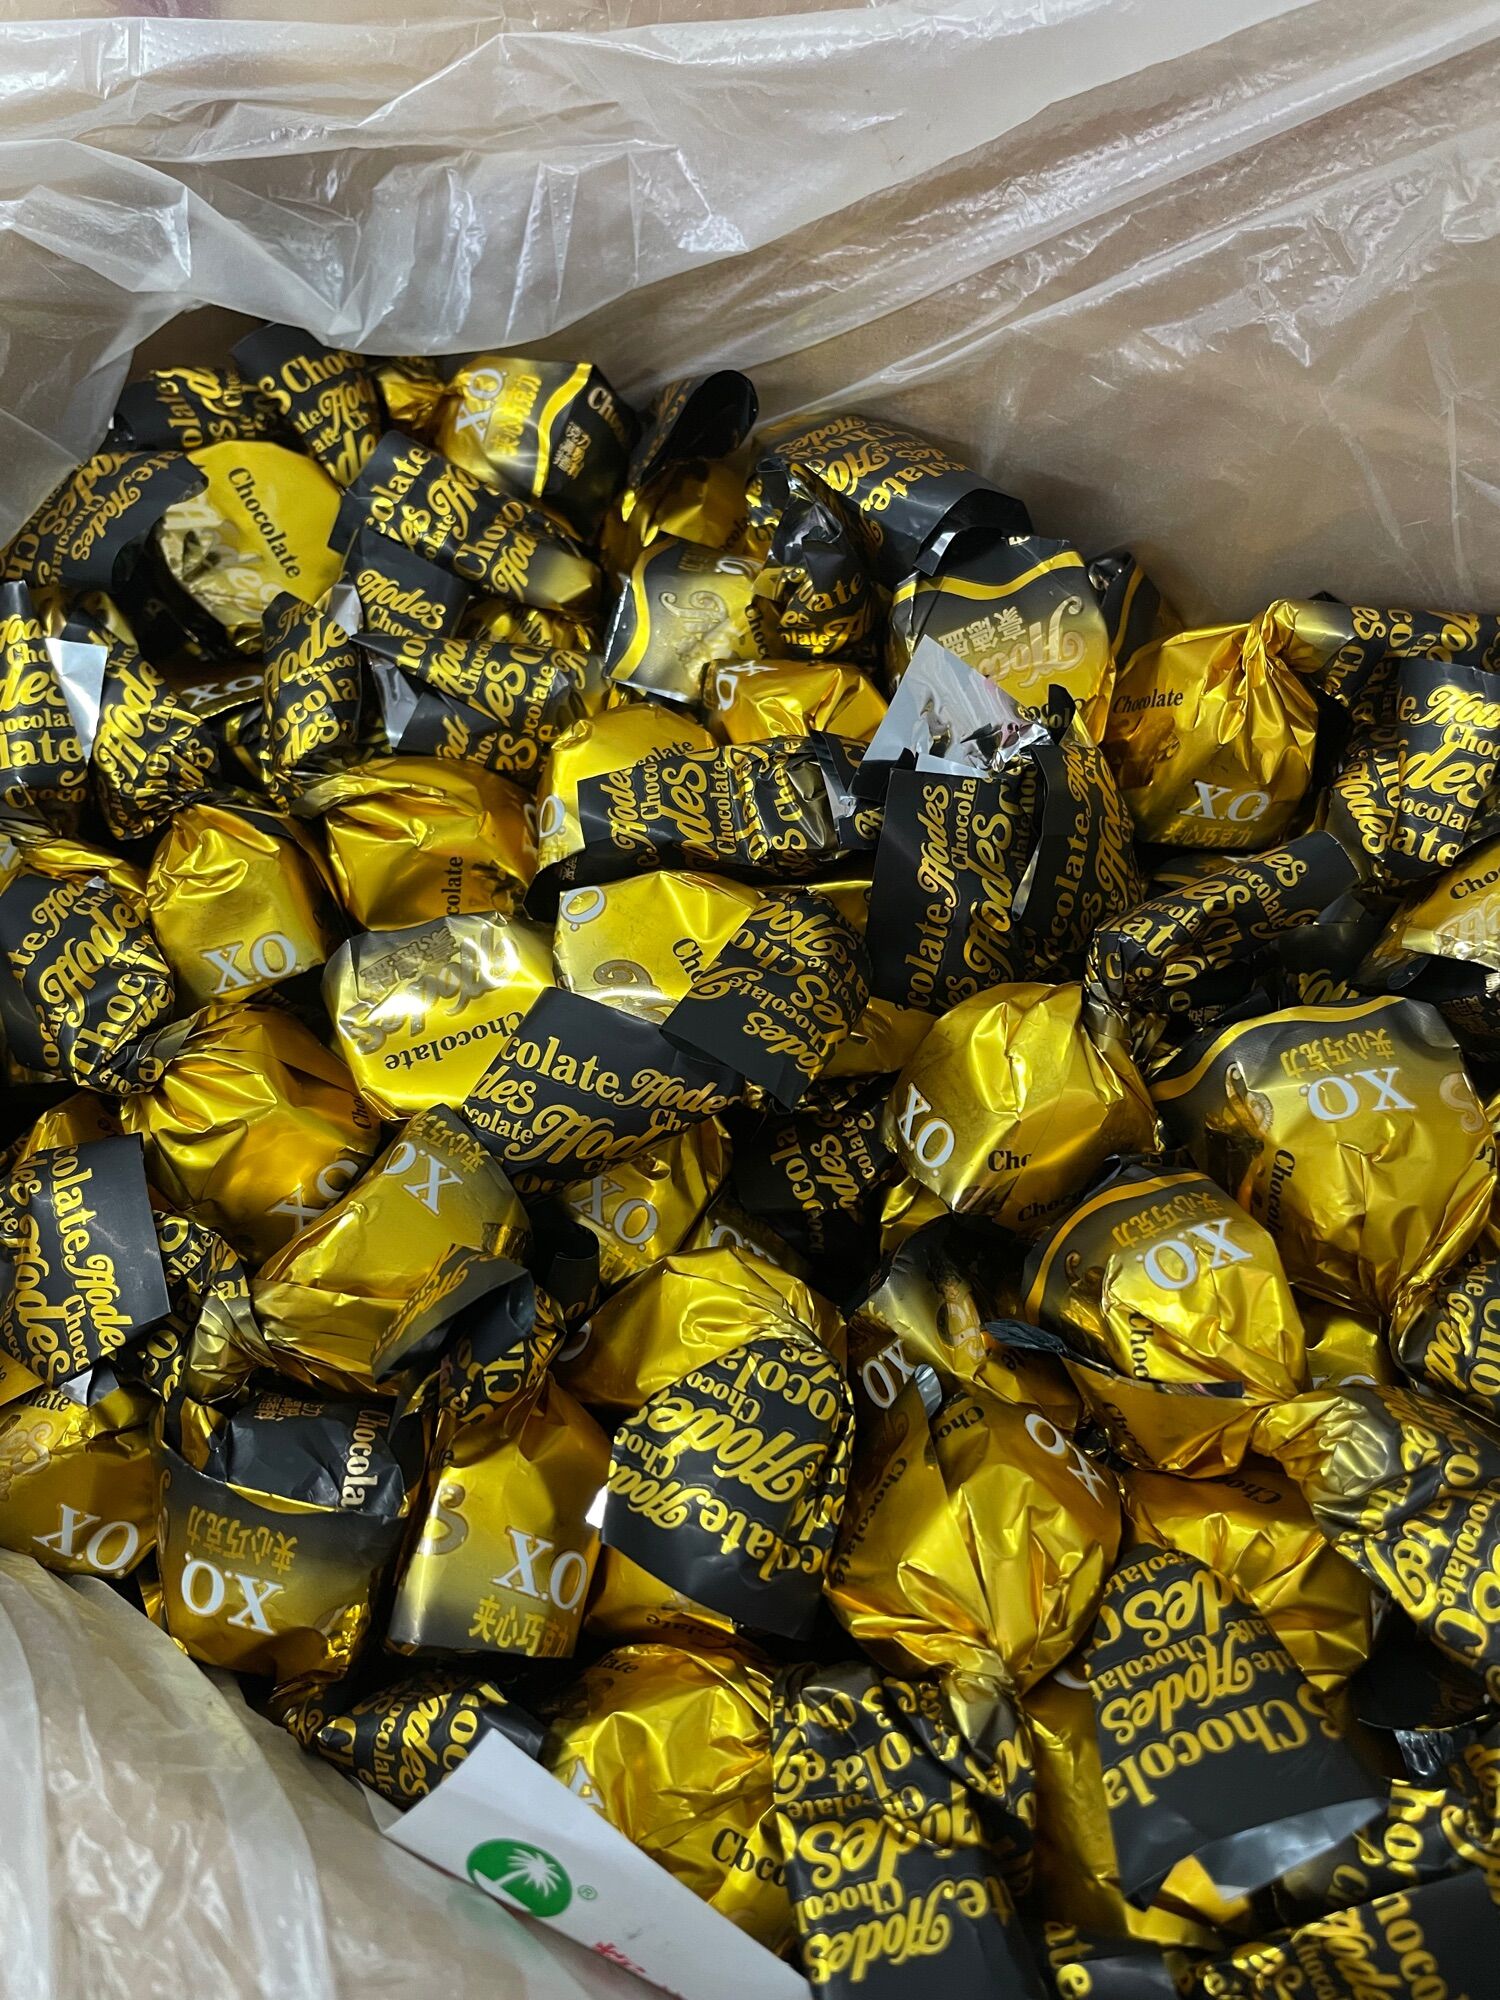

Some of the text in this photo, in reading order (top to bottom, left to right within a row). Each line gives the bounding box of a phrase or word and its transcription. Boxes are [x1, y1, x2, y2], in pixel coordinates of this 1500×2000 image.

[228, 466, 301, 579] Chocolate
[364, 447, 432, 526] olate
[424, 512, 456, 560] olate
[357, 569, 447, 630] Hodes
[295, 654, 356, 687] Choco
[459, 643, 493, 695] Choco
[95, 660, 165, 779] Hode
[284, 711, 340, 765] des
[716, 760, 737, 855] Chocolate
[1181, 779, 1271, 823] X.O.
[1399, 738, 1497, 807] des
[950, 779, 977, 871] Chocola
[1161, 820, 1254, 849] 夹心巧克力
[445, 856, 464, 917] colate
[904, 783, 960, 1008] colate Hodes
[963, 811, 1015, 983] Hodes
[1050, 812, 1092, 942] colate
[38, 902, 141, 1028] Hode
[201, 929, 305, 996] X.O.
[741, 1010, 824, 1080] odes
[1279, 1026, 1397, 1079] 夹心巧克力
[470, 1065, 537, 1115] des
[1298, 1066, 1418, 1122] X.O.
[1111, 1189, 1226, 1249] 夹心巧克力
[1134, 1216, 1254, 1292] X.O.
[166, 1231, 215, 1284] olate
[63, 1294, 91, 1372] Choco
[339, 1407, 392, 1508] Chocola
[31, 1502, 141, 1578] X.O.
[186, 1504, 299, 1576] 夹心巧克力
[489, 1524, 589, 1616] X.O.
[180, 1551, 286, 1635] X.O.
[1100, 1633, 1253, 1745] Hodes
[1102, 1699, 1308, 1808] Chocola
[804, 1879, 955, 1983] Hodes
